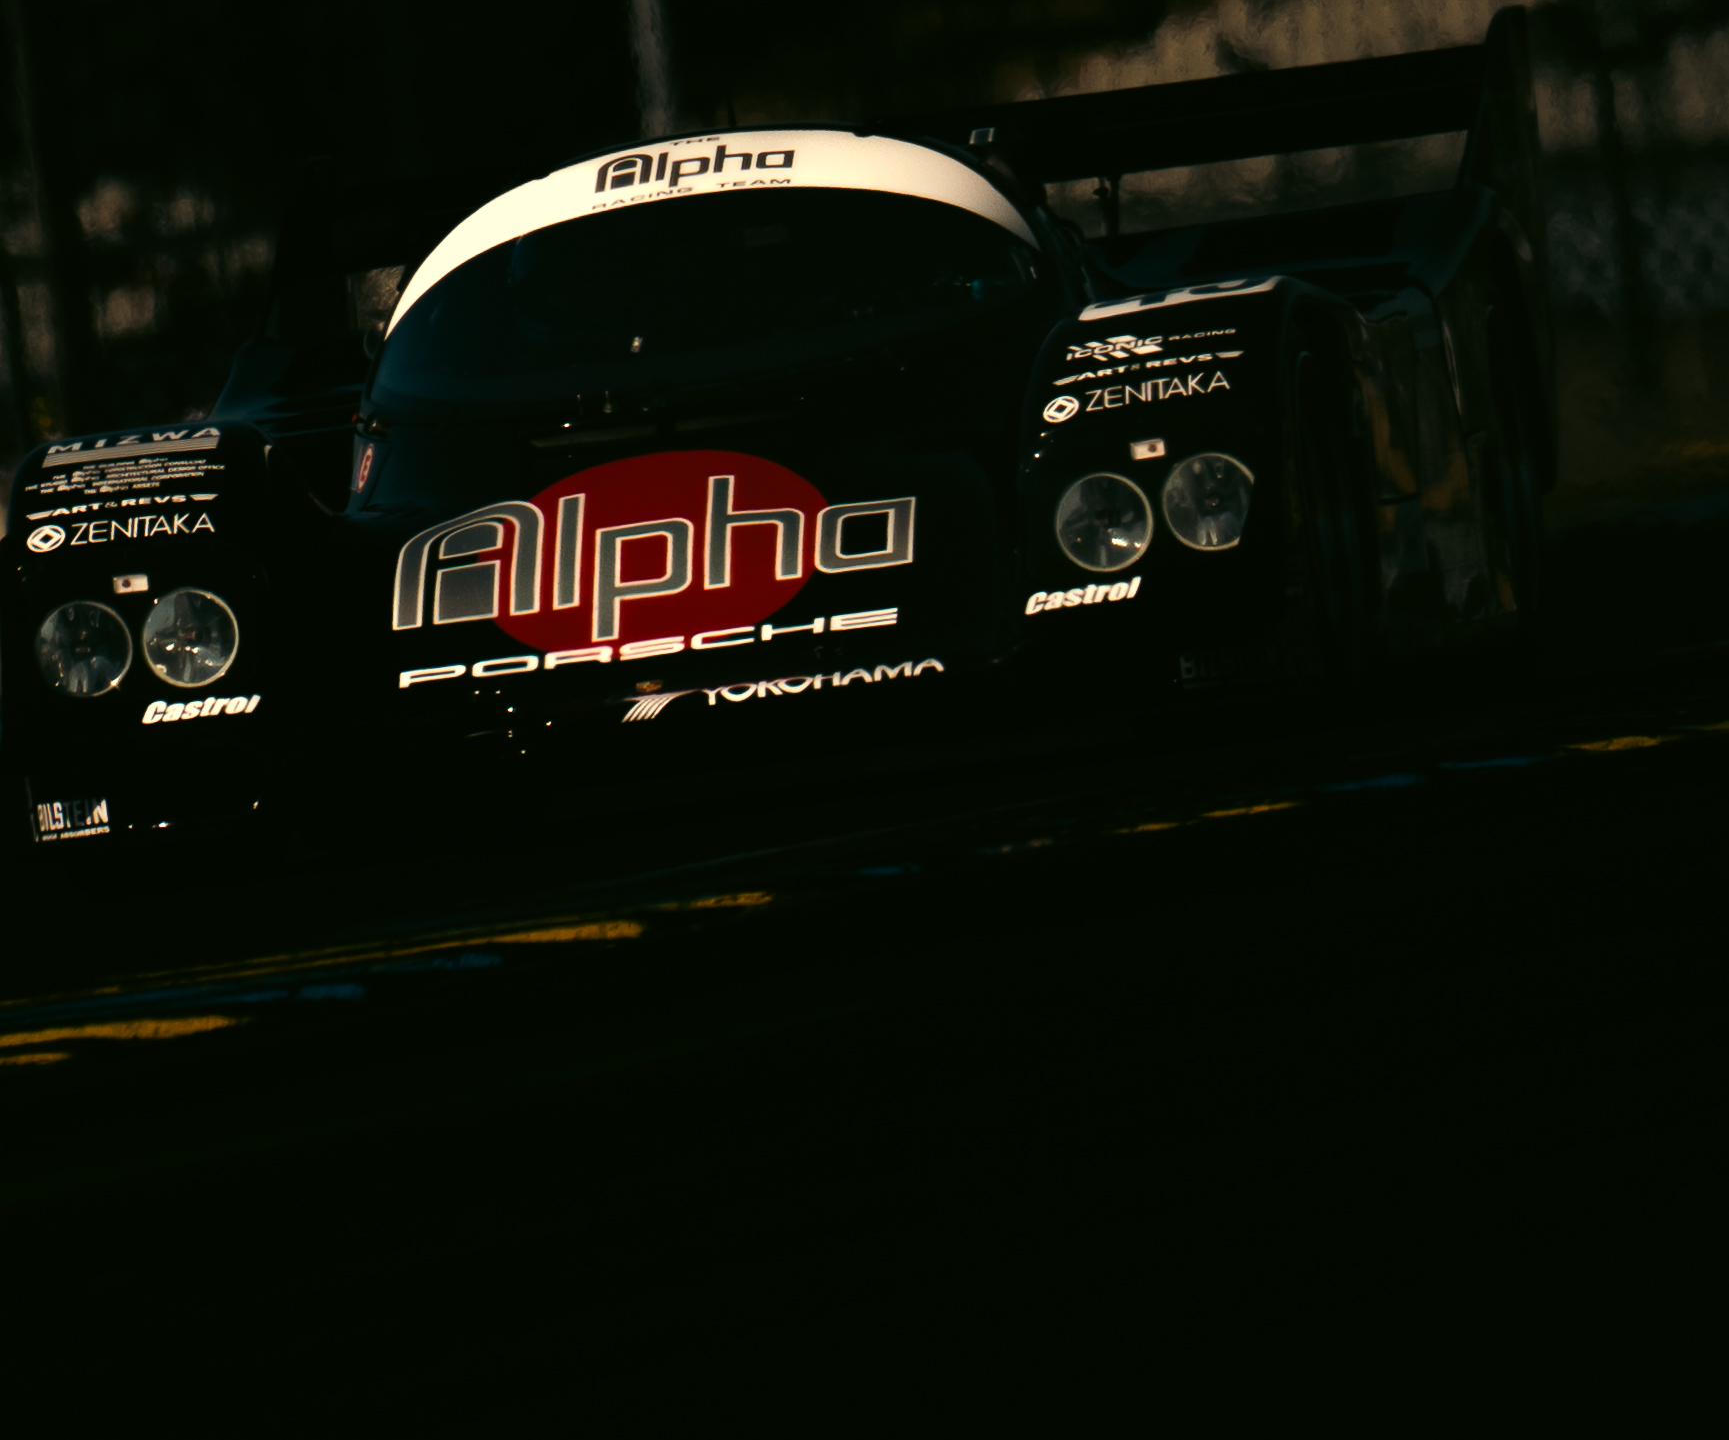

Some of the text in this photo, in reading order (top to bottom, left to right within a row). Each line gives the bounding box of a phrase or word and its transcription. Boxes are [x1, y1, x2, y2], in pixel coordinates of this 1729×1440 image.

[673, 137, 720, 146] THE
[595, 145, 795, 194] Alpha
[592, 179, 791, 210] RACING TEAM
[1066, 328, 1236, 361] ICONIC RACING
[1145, 353, 1214, 369] REVS
[1085, 371, 1231, 412] ZENITAKA
[47, 426, 221, 454] MIZWA
[121, 494, 187, 507] REVS
[70, 512, 216, 546] ZENITAKA
[392, 475, 916, 643] Alpha
[1025, 575, 1142, 615] Castrol
[399, 607, 899, 688] PORSCHE
[702, 658, 945, 706] YOKOHAMA
[142, 693, 262, 725] Castrol
[37, 796, 108, 832] BILSTEIN
